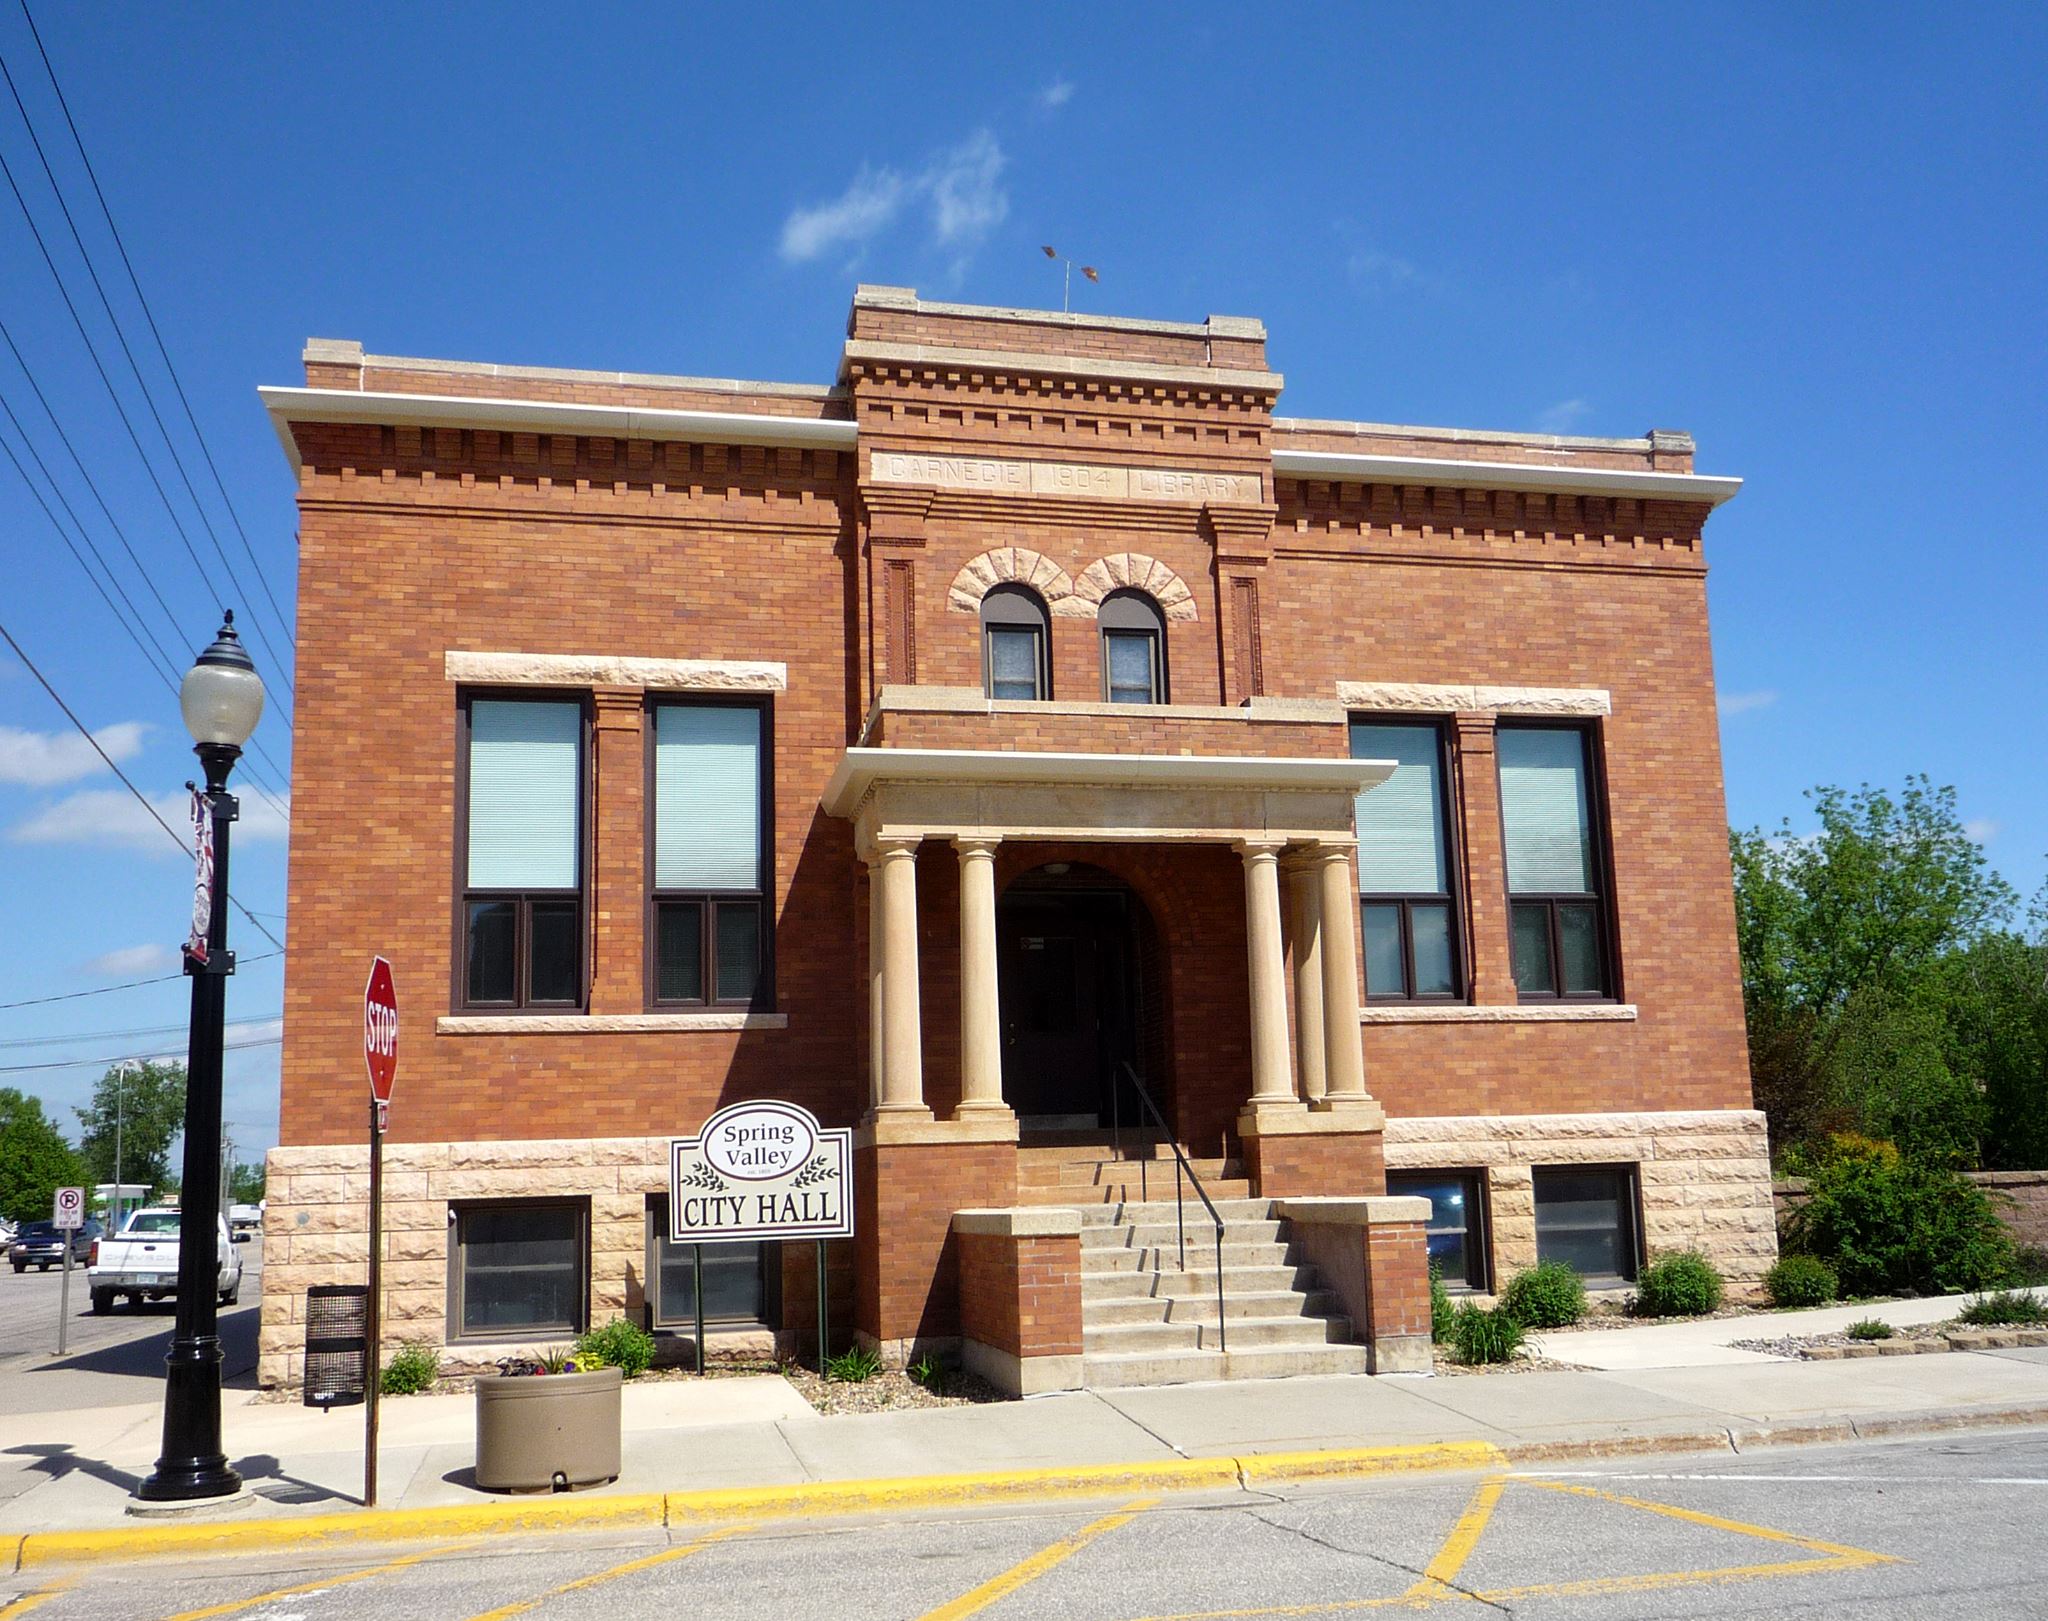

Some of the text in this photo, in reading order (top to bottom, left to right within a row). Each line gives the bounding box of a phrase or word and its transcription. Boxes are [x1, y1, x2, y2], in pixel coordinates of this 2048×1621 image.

[891, 457, 1244, 497] CARNEGIE 1904 LIBRARY
[367, 1001, 396, 1057] STOP
[724, 1123, 795, 1147] Spring
[726, 1147, 793, 1169] Valley
[684, 1192, 837, 1227] CITY HALL
